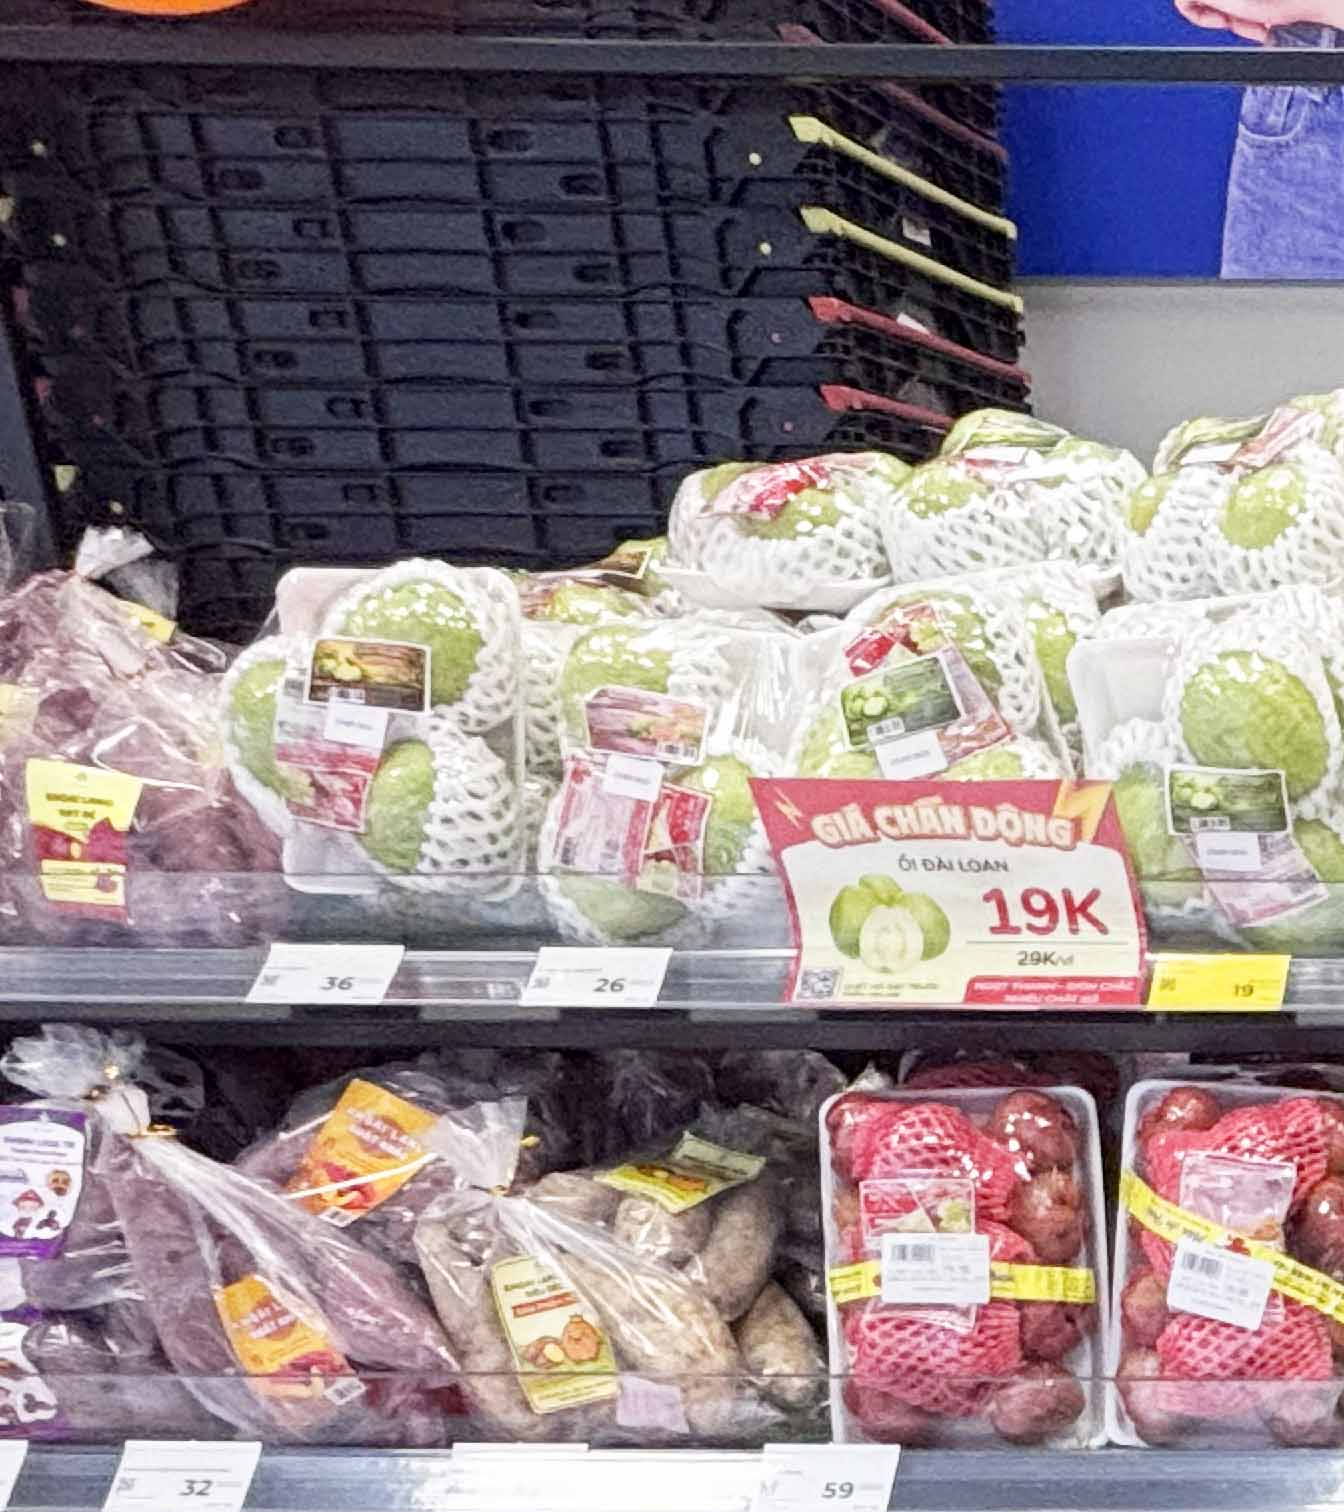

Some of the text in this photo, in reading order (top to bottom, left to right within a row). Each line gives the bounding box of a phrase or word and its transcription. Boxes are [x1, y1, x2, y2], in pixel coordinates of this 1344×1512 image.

[959, 856, 1010, 873] LOAN
[982, 886, 1110, 936] 19K
[321, 976, 355, 991] 36
[593, 977, 625, 993] 26
[1234, 983, 1255, 997] 19
[180, 1479, 213, 1497] 32
[821, 1481, 854, 1499] 59
